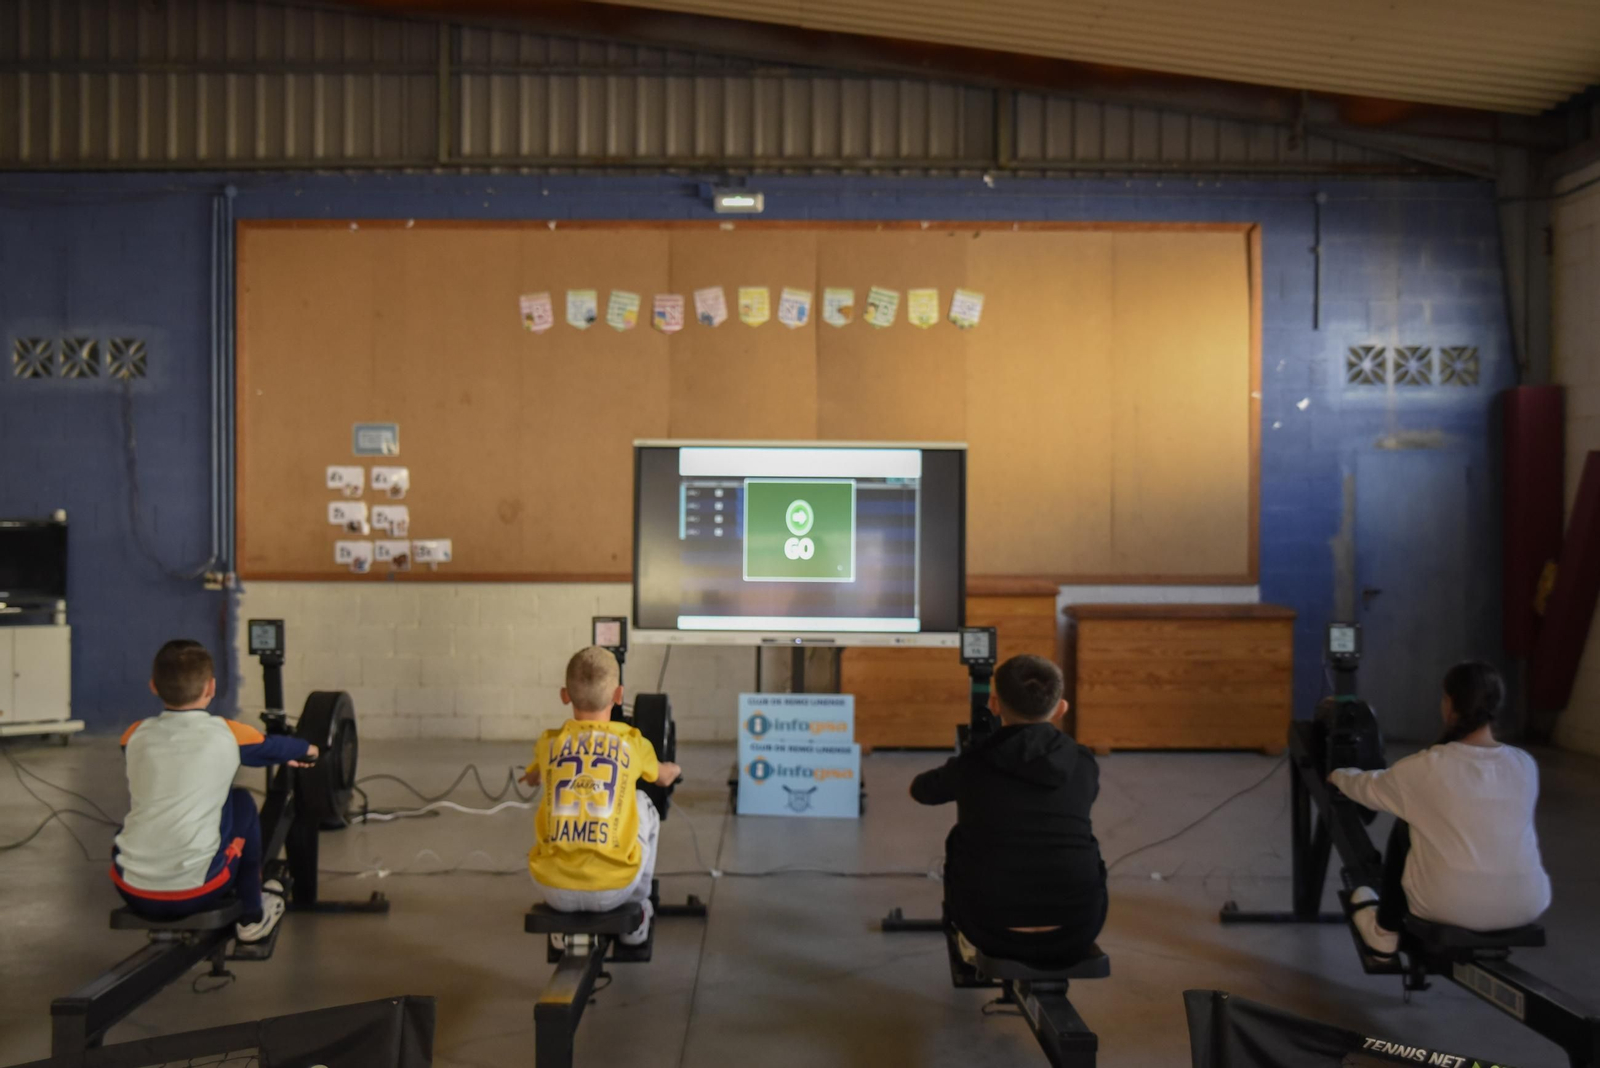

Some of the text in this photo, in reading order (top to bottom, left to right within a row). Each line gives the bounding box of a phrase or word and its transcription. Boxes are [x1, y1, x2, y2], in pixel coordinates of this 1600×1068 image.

[784, 537, 815, 560] GO
[770, 697, 782, 706] DE
[549, 730, 630, 769] LAKERS
[774, 744, 786, 752] DE
[552, 755, 618, 819] 23
[551, 820, 609, 844] JAMES
[1362, 1037, 1466, 1068] TENNIS NET
